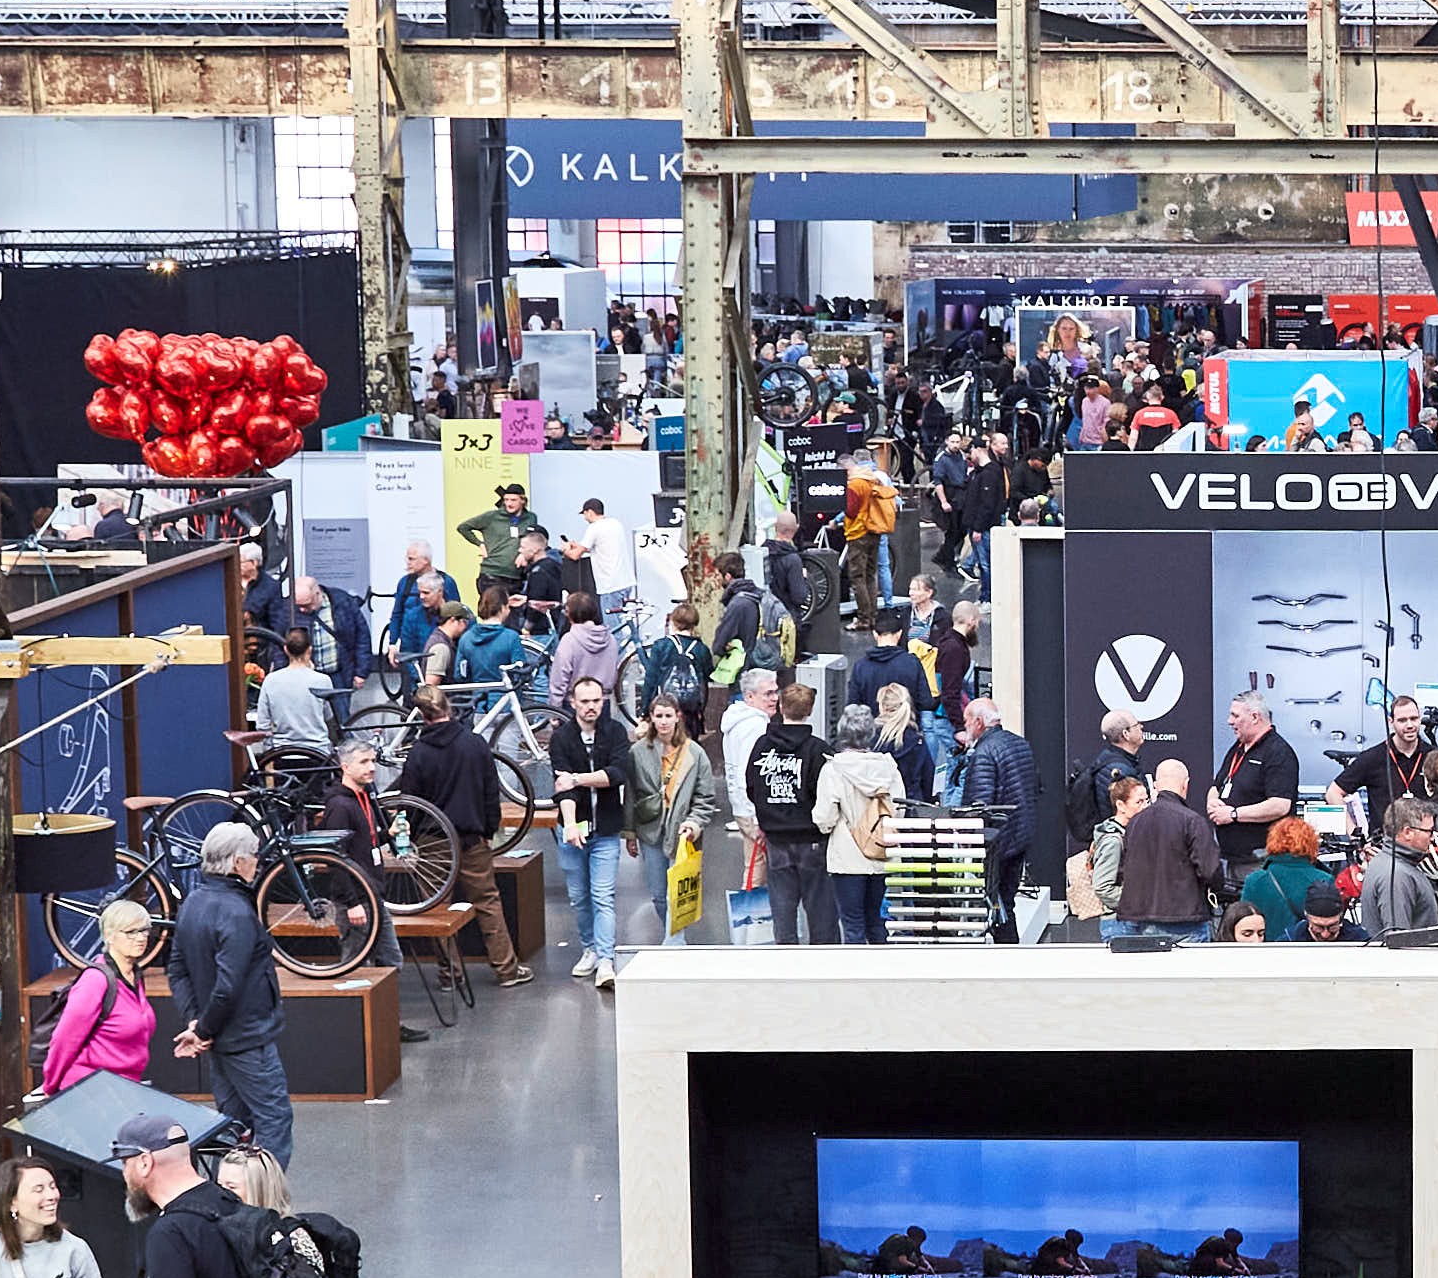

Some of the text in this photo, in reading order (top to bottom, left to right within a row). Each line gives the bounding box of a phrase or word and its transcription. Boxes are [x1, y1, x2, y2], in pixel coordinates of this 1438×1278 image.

[464, 61, 502, 106] 13
[1101, 70, 1153, 112] 18
[1021, 296, 1130, 307] KALKHOFF
[1209, 371, 1220, 415] MOTUL
[660, 426, 683, 436] coboc
[455, 456, 493, 469] NINE
[808, 482, 845, 497] coboc
